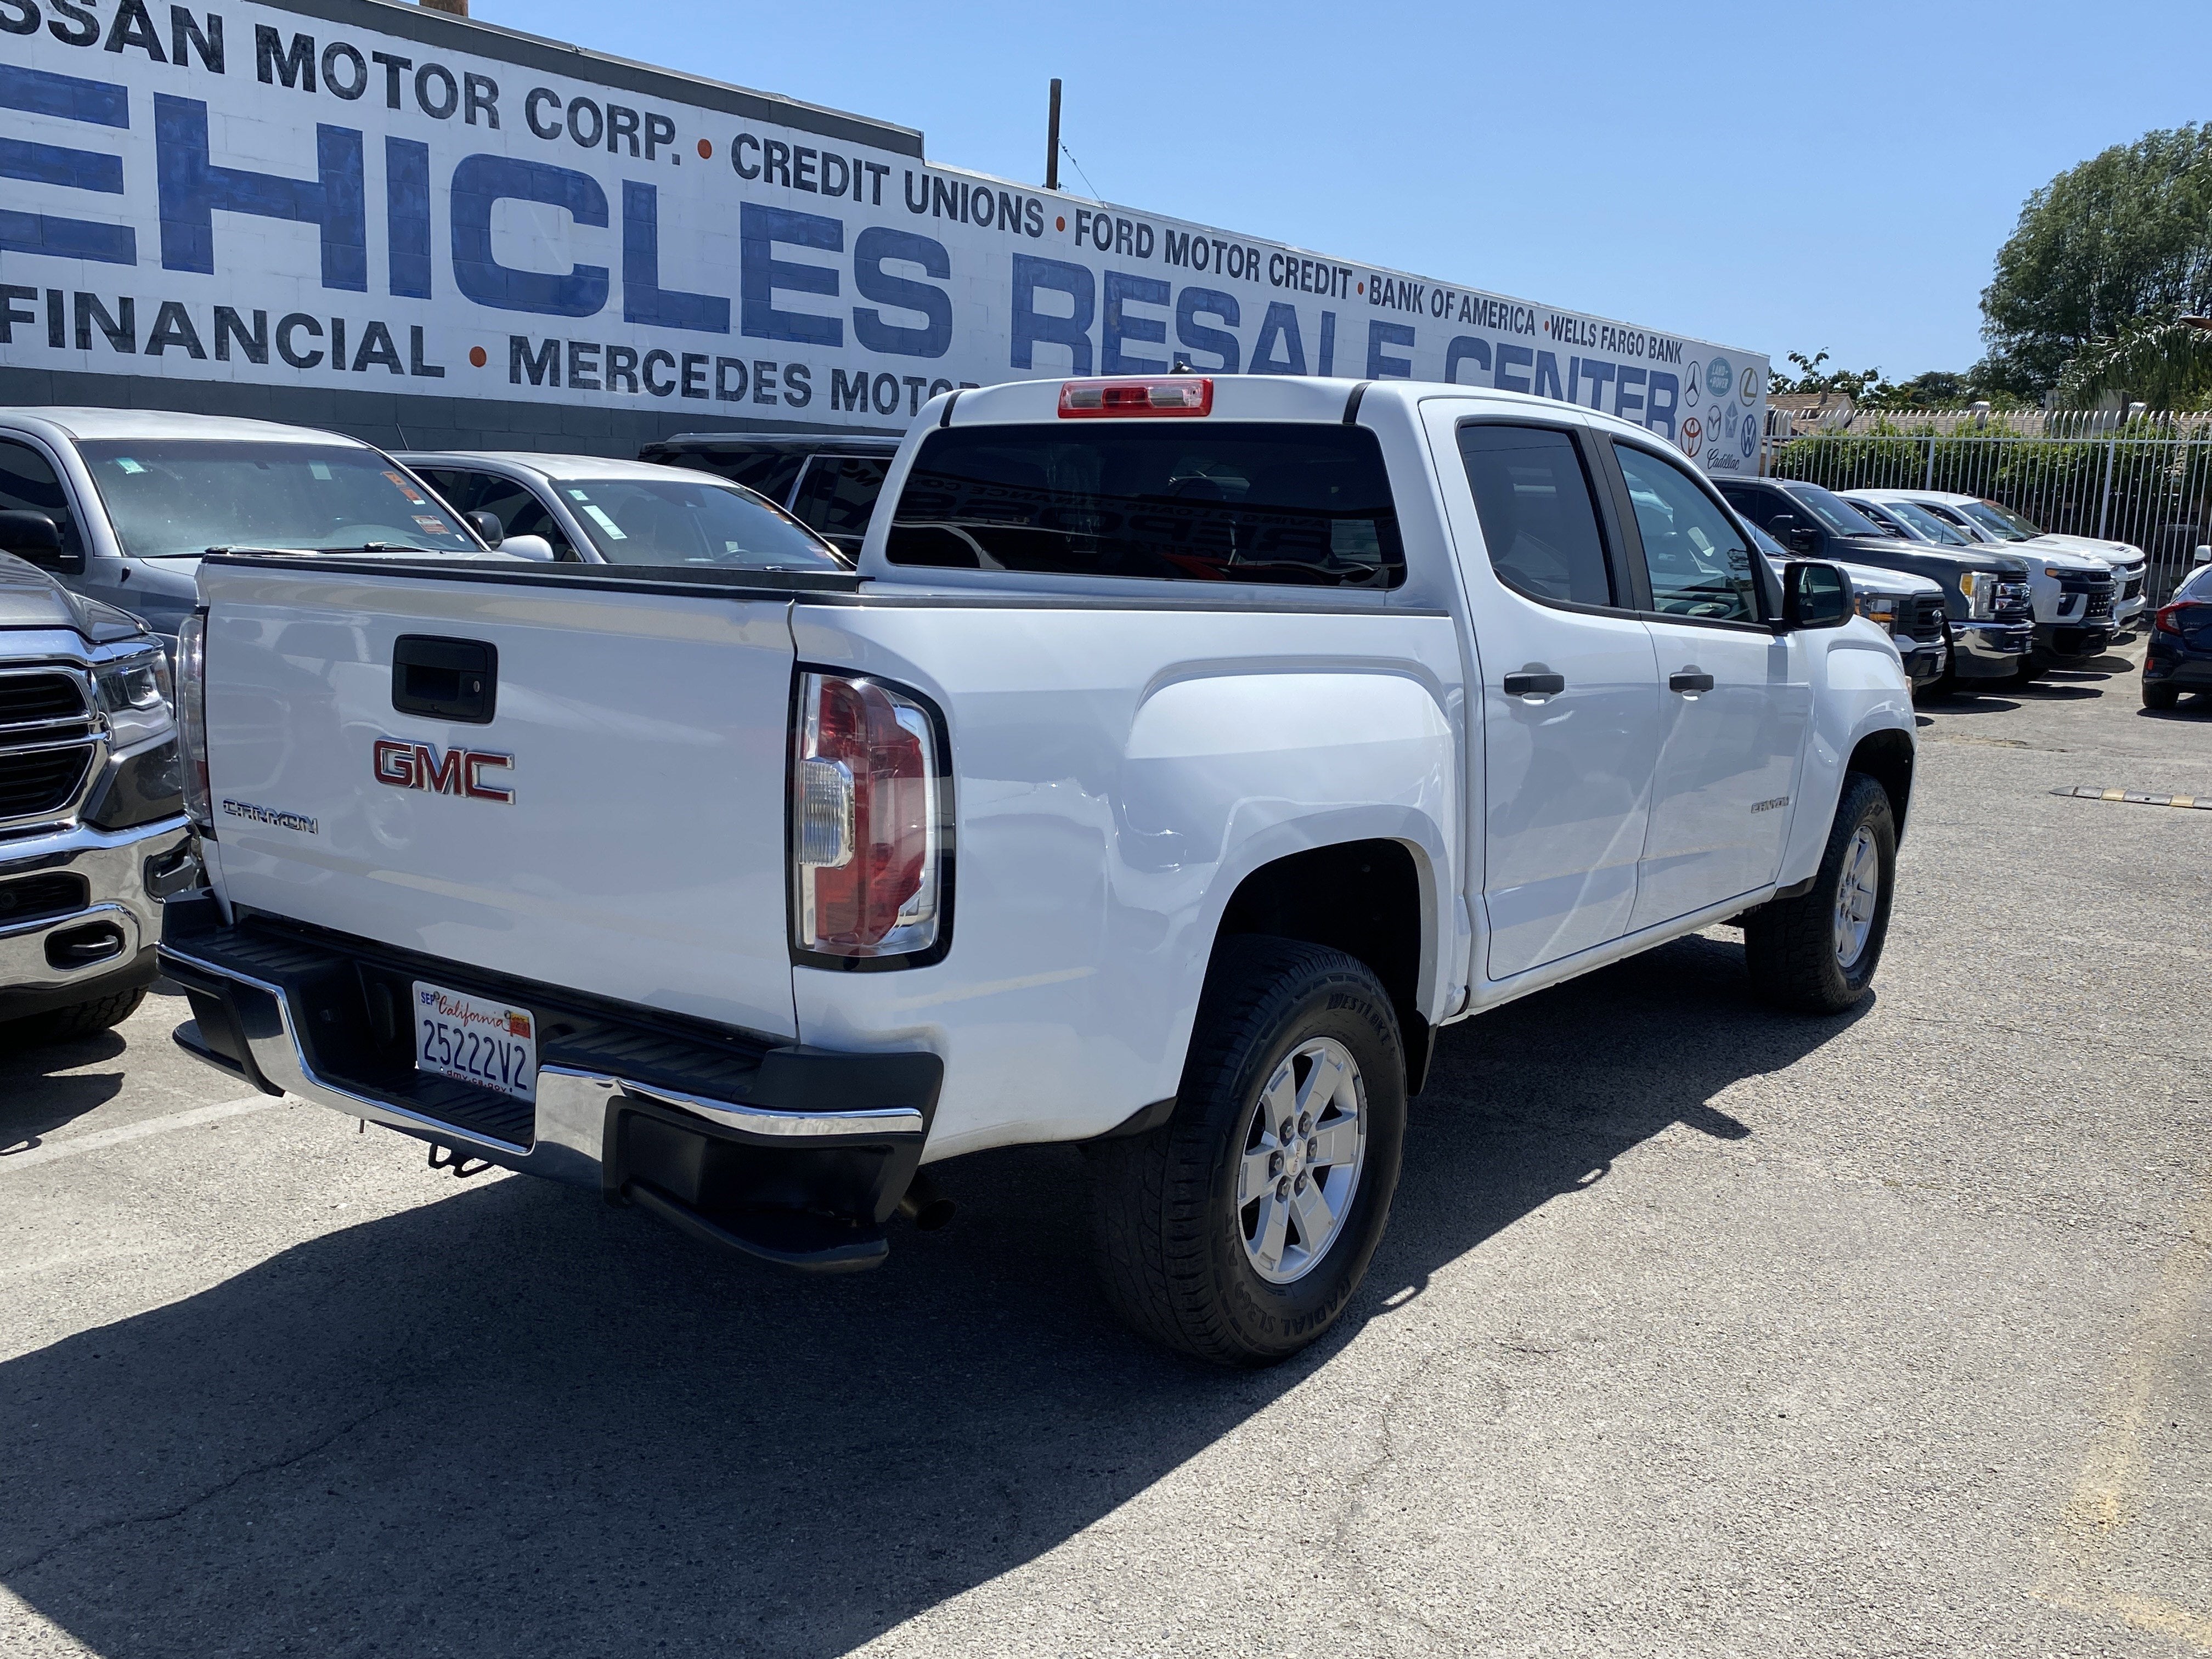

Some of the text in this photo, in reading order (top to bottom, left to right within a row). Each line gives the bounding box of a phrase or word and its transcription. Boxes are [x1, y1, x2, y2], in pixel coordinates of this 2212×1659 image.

[0, 64, 953, 358] EHICLES
[255, 24, 500, 130] MOTOR
[524, 87, 681, 166] CORP.
[731, 133, 890, 206] CREDIT
[905, 171, 1044, 238] UNIONS
[1075, 208, 1154, 259] FORD
[1164, 229, 1261, 282] MOTOR
[1268, 253, 1352, 300] CREDIT
[1369, 275, 1425, 314] BANK
[1431, 289, 1456, 320] OF
[1458, 295, 1536, 336] AMERICA
[1550, 314, 1596, 348] WELLS
[1600, 326, 1645, 357] FARGO
[1649, 336, 1683, 365] BANK
[0, 284, 980, 417] FINANCIAL MERCEDES MOT
[1707, 448, 1740, 470] Cadillac
[373, 736, 516, 805] GMC
[222, 798, 319, 835] CANYON
[1750, 795, 1790, 814] CANYON
[421, 991, 435, 1006] SEP
[438, 995, 511, 1031] California
[1325, 992, 1391, 1046] WESTLAKE
[423, 1019, 527, 1091] 25222V2
[447, 1070, 506, 1093] dmv.ca.gov
[1291, 1142, 1302, 1173] GMC
[1234, 1280, 1276, 1335] SL369
[1280, 1277, 1352, 1338] RADIAL
